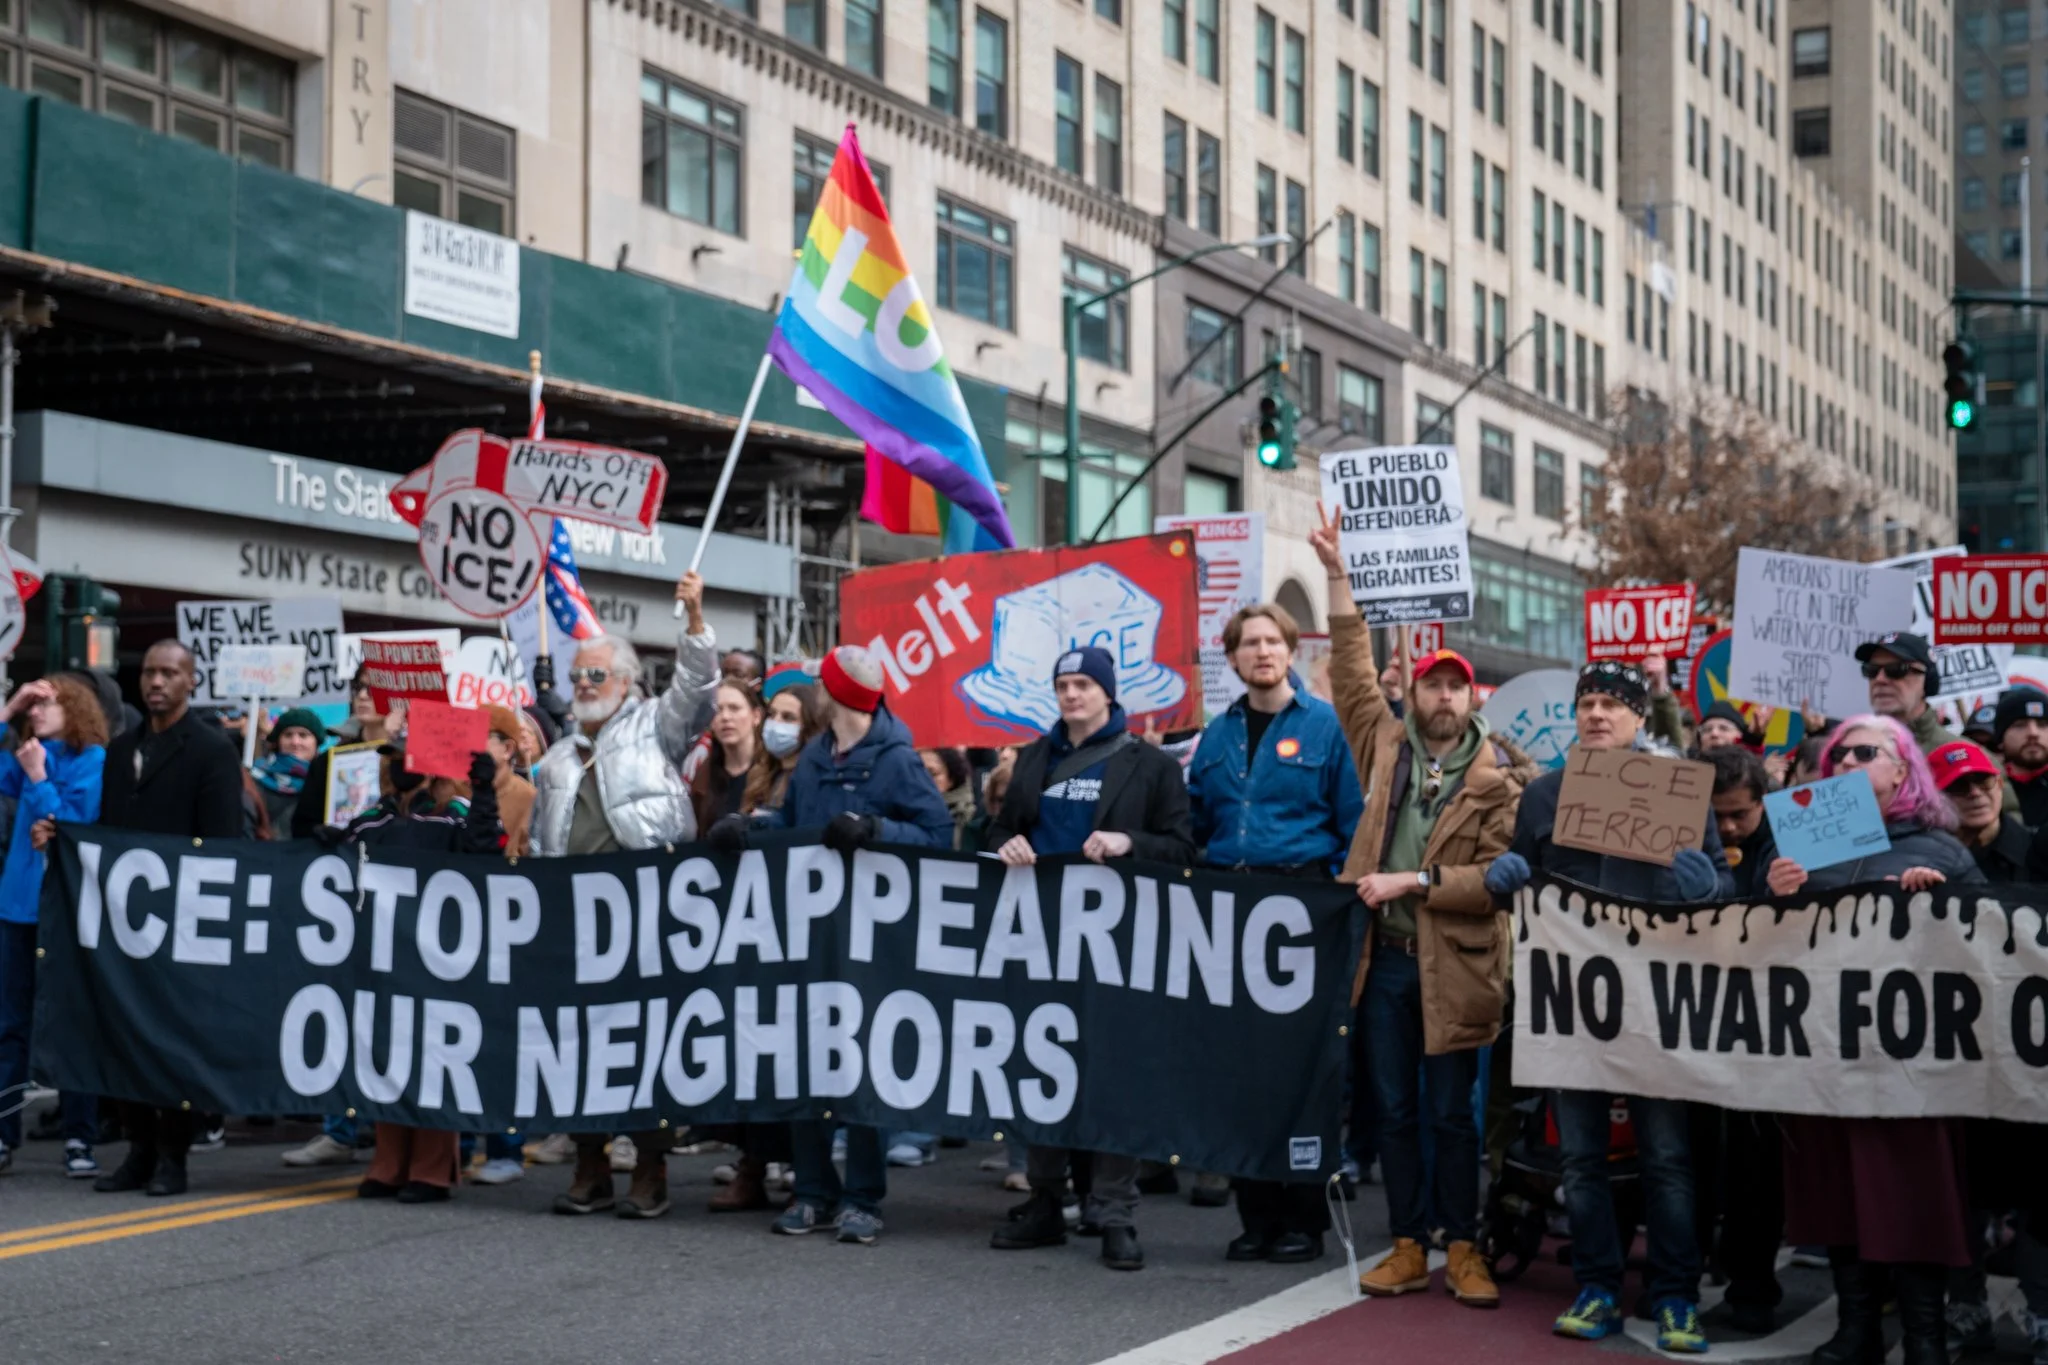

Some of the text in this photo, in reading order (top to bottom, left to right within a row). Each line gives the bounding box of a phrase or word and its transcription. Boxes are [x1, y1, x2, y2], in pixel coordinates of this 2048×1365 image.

[513, 444, 651, 485] Hands Off
[1369, 452, 1448, 475] PUEBLO
[268, 455, 327, 511] The
[563, 517, 616, 558] New
[619, 523, 667, 566] York
[537, 475, 629, 518] NYC!
[1344, 475, 1442, 511] UNIDO
[451, 501, 515, 550] NO
[240, 543, 310, 584] SUNY
[320, 553, 389, 594] State
[443, 544, 533, 604] ICE!
[1351, 545, 1459, 568] LAS FAMILIAS
[1773, 587, 1799, 618] ICE
[1840, 567, 1871, 599] LIKE
[1940, 570, 1998, 620] NO
[2009, 569, 2048, 620] IC
[184, 605, 273, 633] WE WE
[1590, 600, 1637, 643] NO
[1644, 597, 1692, 641] ICE!
[1940, 622, 1983, 636] HANDS
[1986, 622, 2009, 635] OFF
[383, 644, 440, 664] POWERS
[1943, 644, 1997, 677] ZUELA
[1813, 779, 1849, 800] NYC
[1556, 803, 1697, 854] TERROR
[1776, 796, 1860, 833] ABOLISH
[1809, 818, 1850, 846] ICE
[78, 842, 1316, 1015] ICE: STOP DISAPPEARING
[1530, 948, 1624, 1041] NO
[1649, 960, 1812, 1057] WAR
[1839, 969, 1983, 1061] FOR
[280, 980, 1079, 1124] OUR NEIGHBORS
